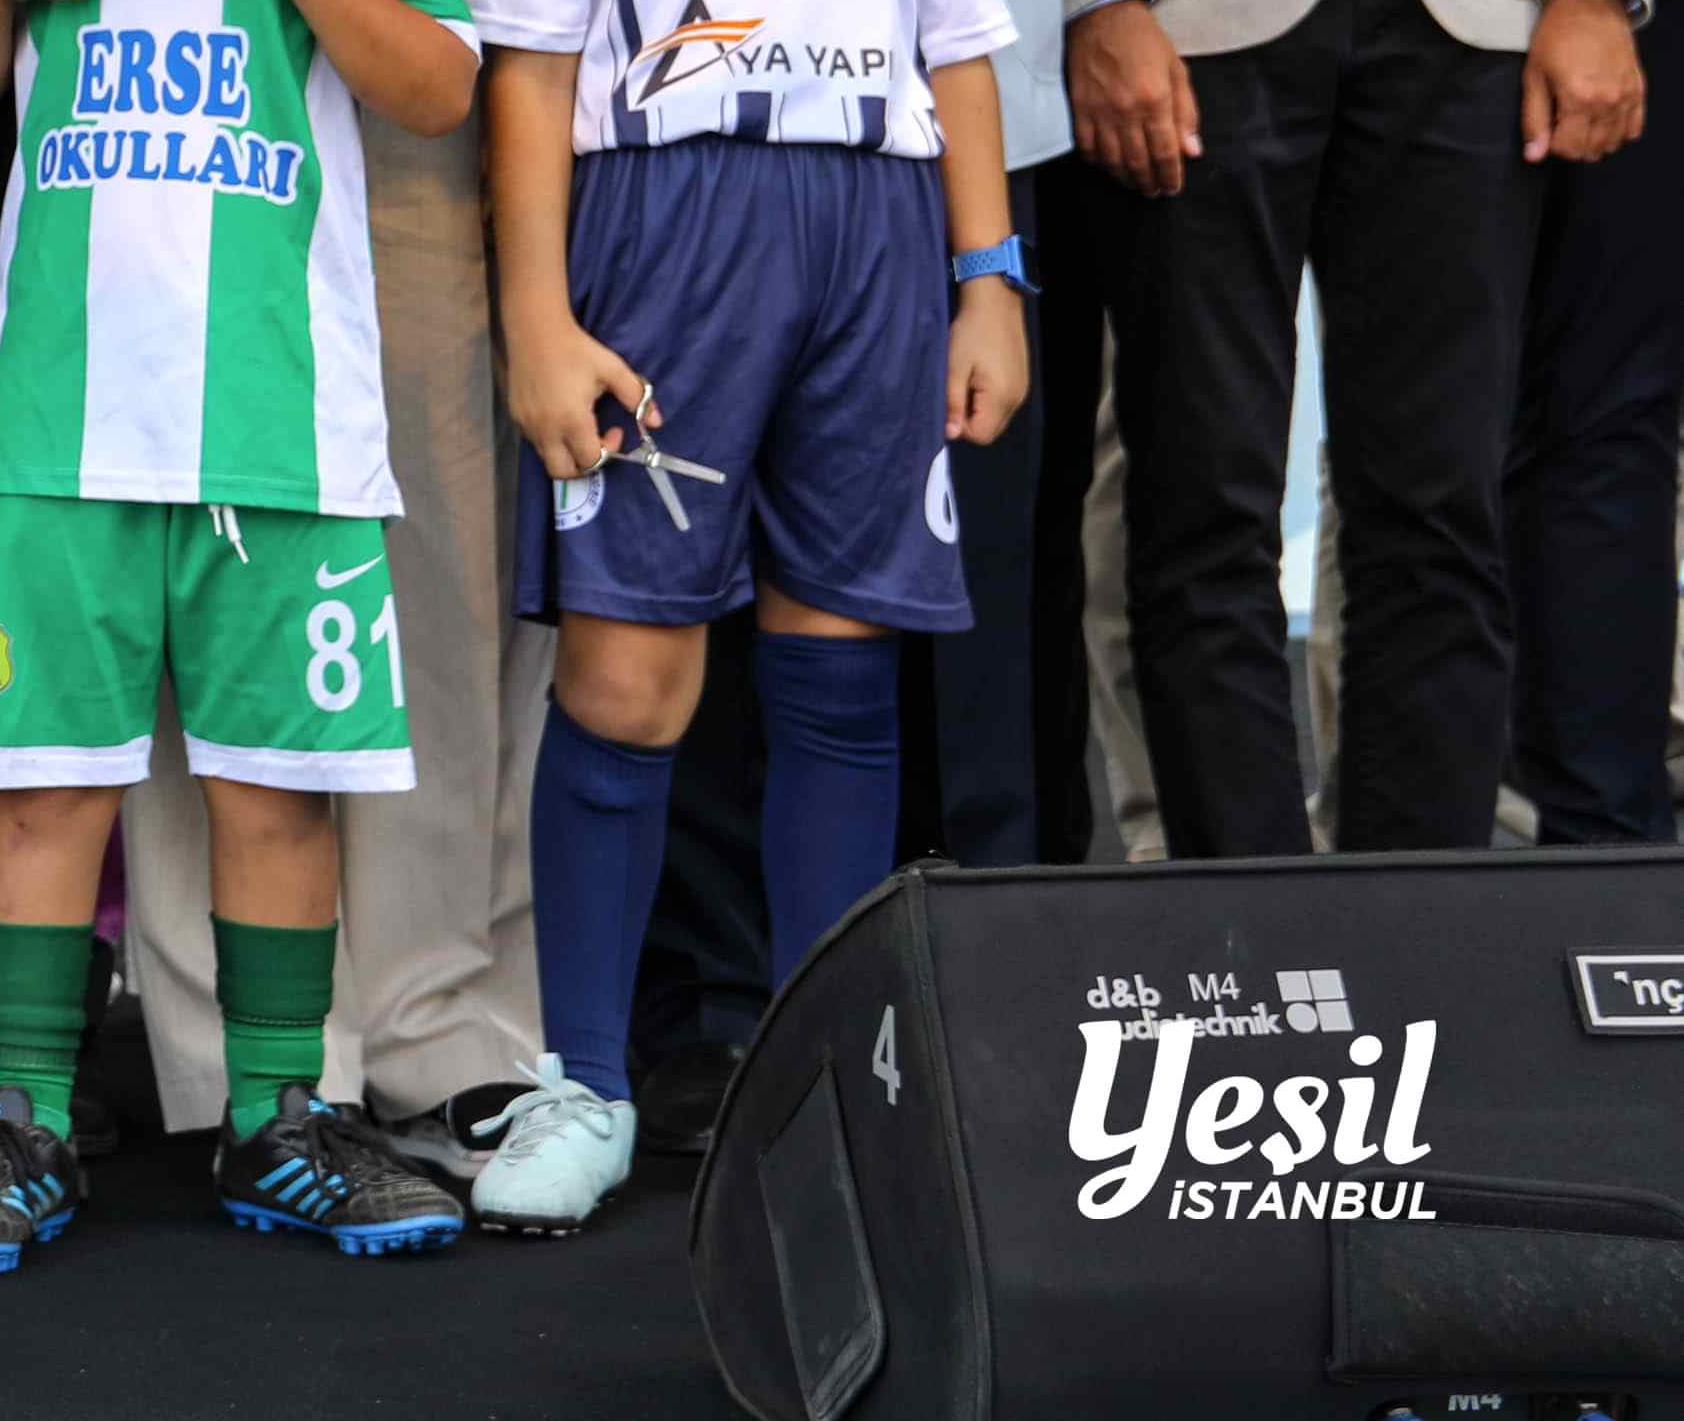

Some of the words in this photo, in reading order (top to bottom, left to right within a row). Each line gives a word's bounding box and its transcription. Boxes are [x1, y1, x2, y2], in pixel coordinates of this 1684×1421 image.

[77, 29, 246, 119] ERSE
[39, 130, 298, 198] OKULLARI
[306, 594, 406, 713] 81
[1086, 973, 1162, 1009] d&b
[1187, 972, 1242, 1002] M4
[872, 1004, 901, 1106] 4
